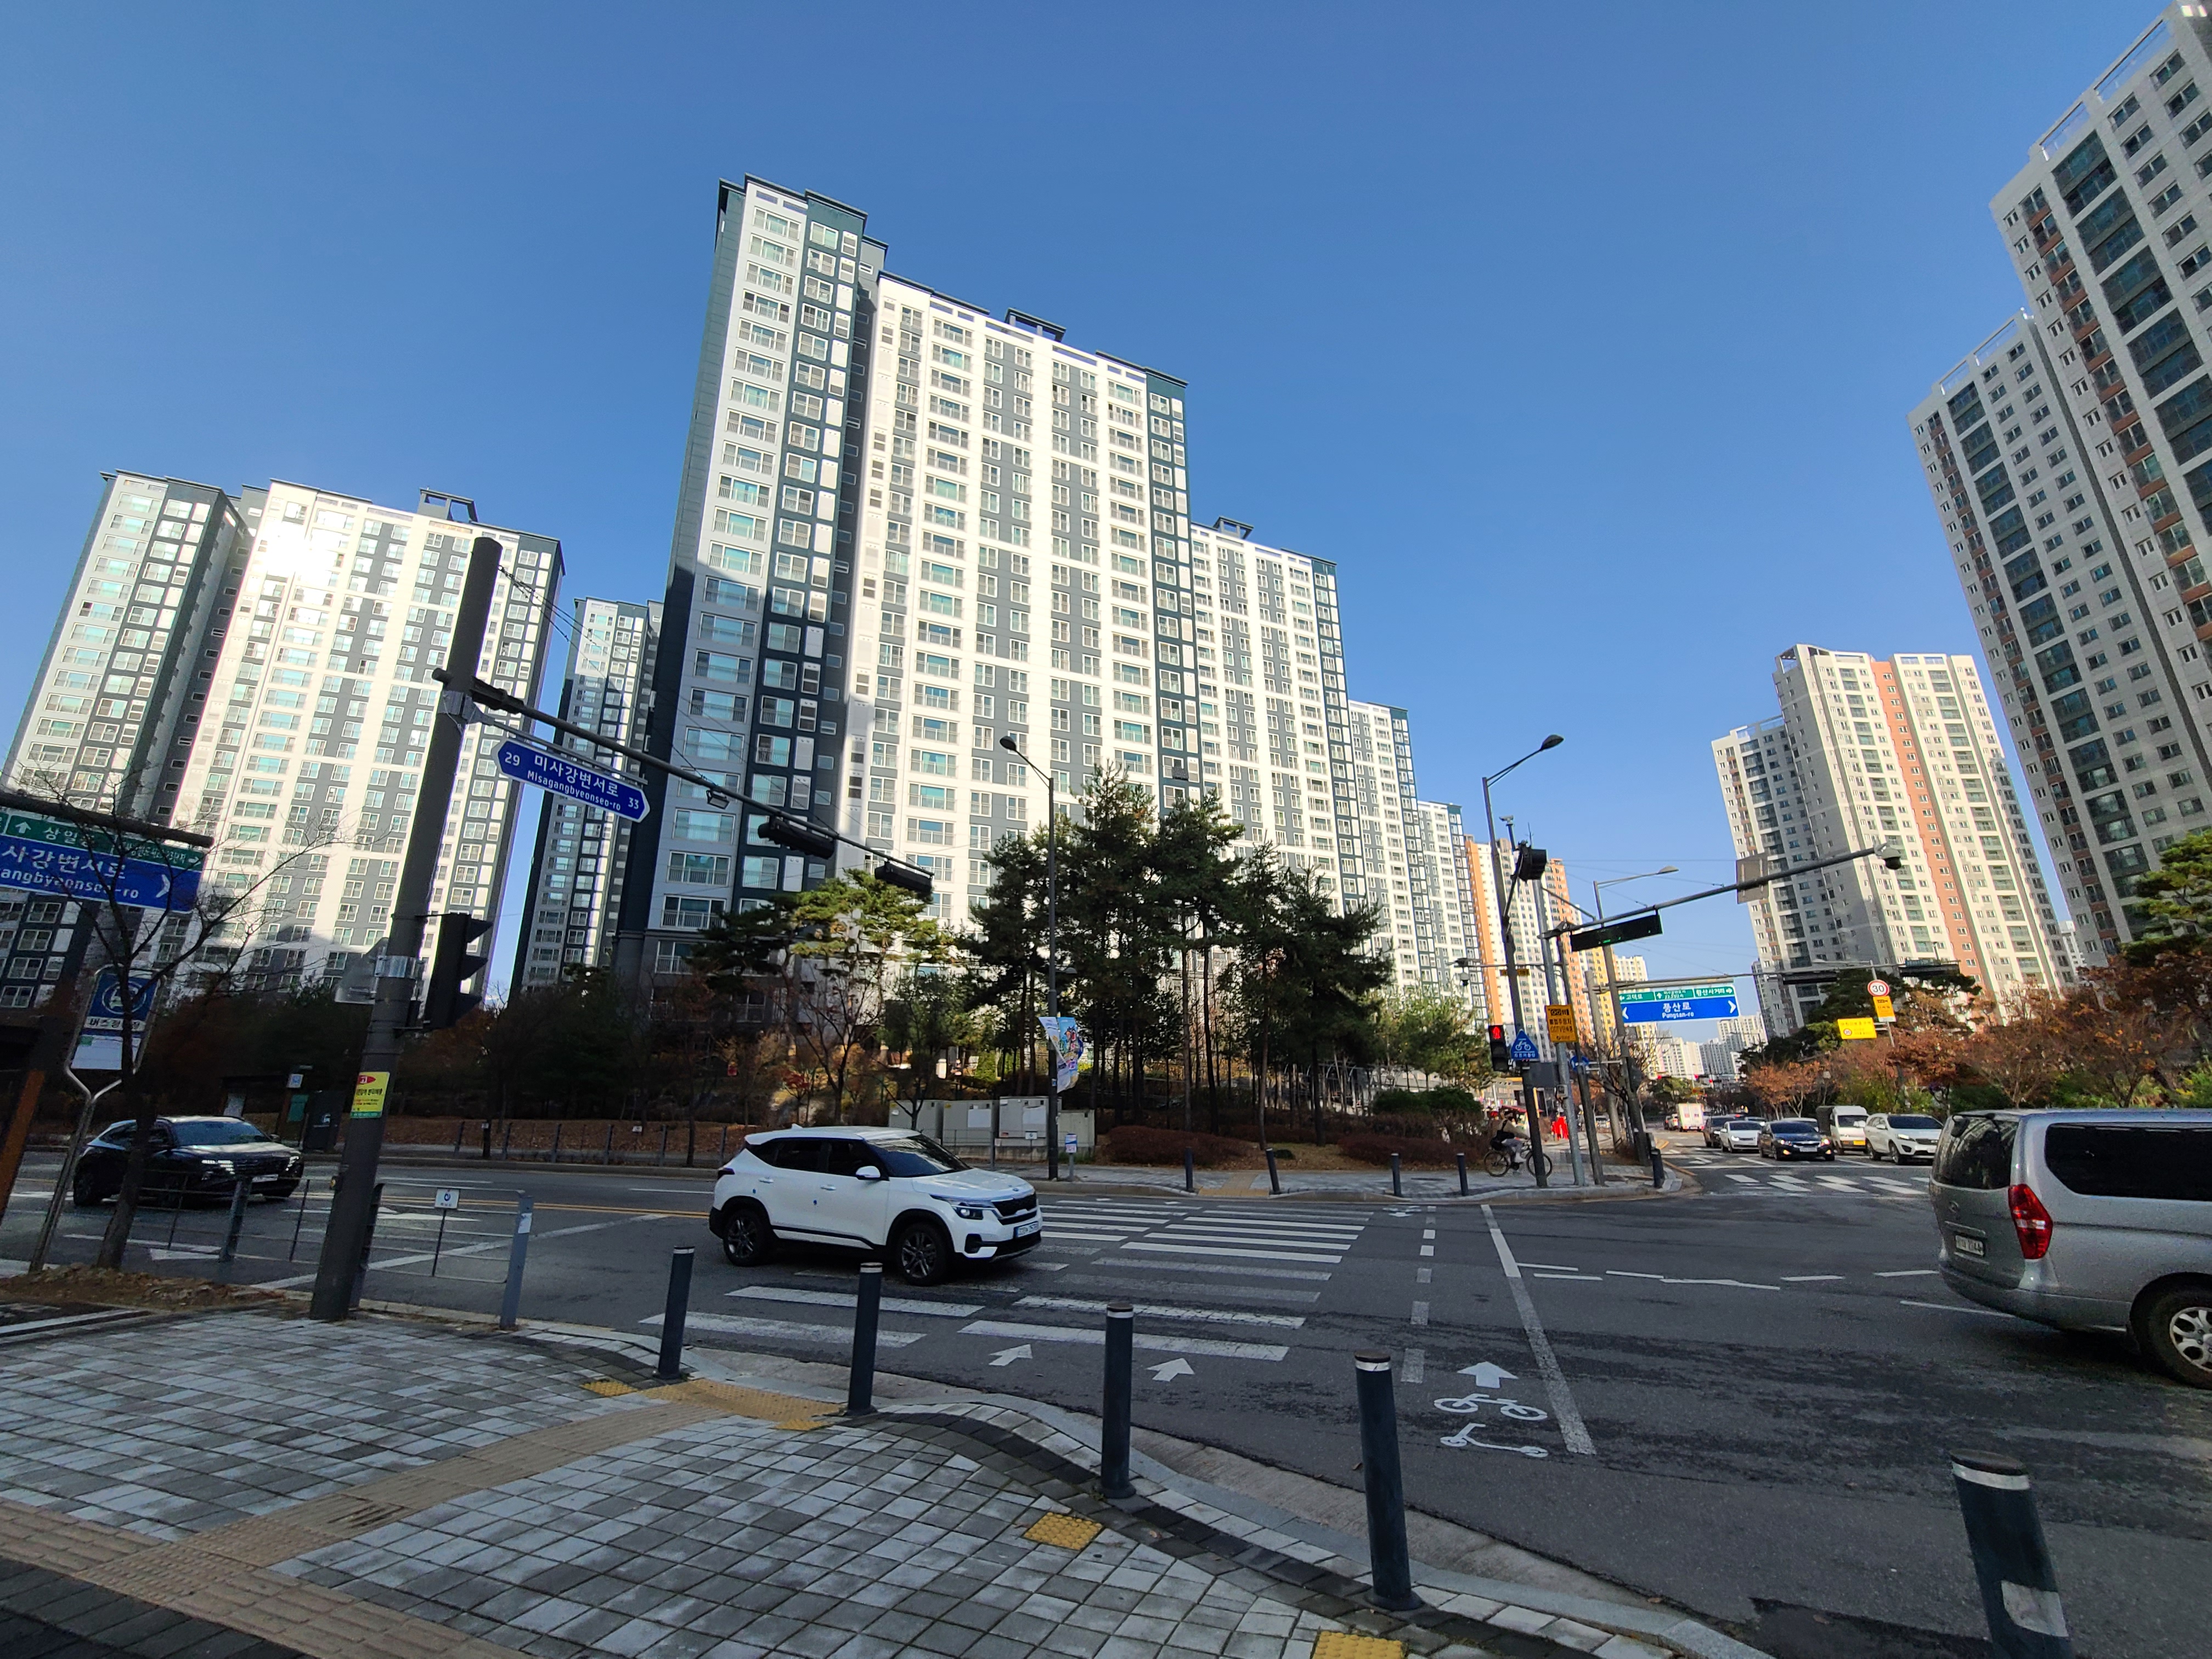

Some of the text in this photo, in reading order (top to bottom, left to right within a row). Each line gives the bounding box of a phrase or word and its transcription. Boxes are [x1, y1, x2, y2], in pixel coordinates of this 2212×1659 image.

[504, 752, 521, 766] 29
[534, 755, 619, 797] 미사강변서로
[527, 770, 621, 811] Misagangbyeonseo-ro
[628, 797, 639, 810] 33
[0, 845, 126, 879] 사강변서로
[0, 868, 139, 899] angbyeonse-ro
[1662, 1001, 1692, 1013] 풍산로
[1662, 1011, 1695, 1019] Pungsan-ro
[89, 1018, 140, 1029] 버스정장
